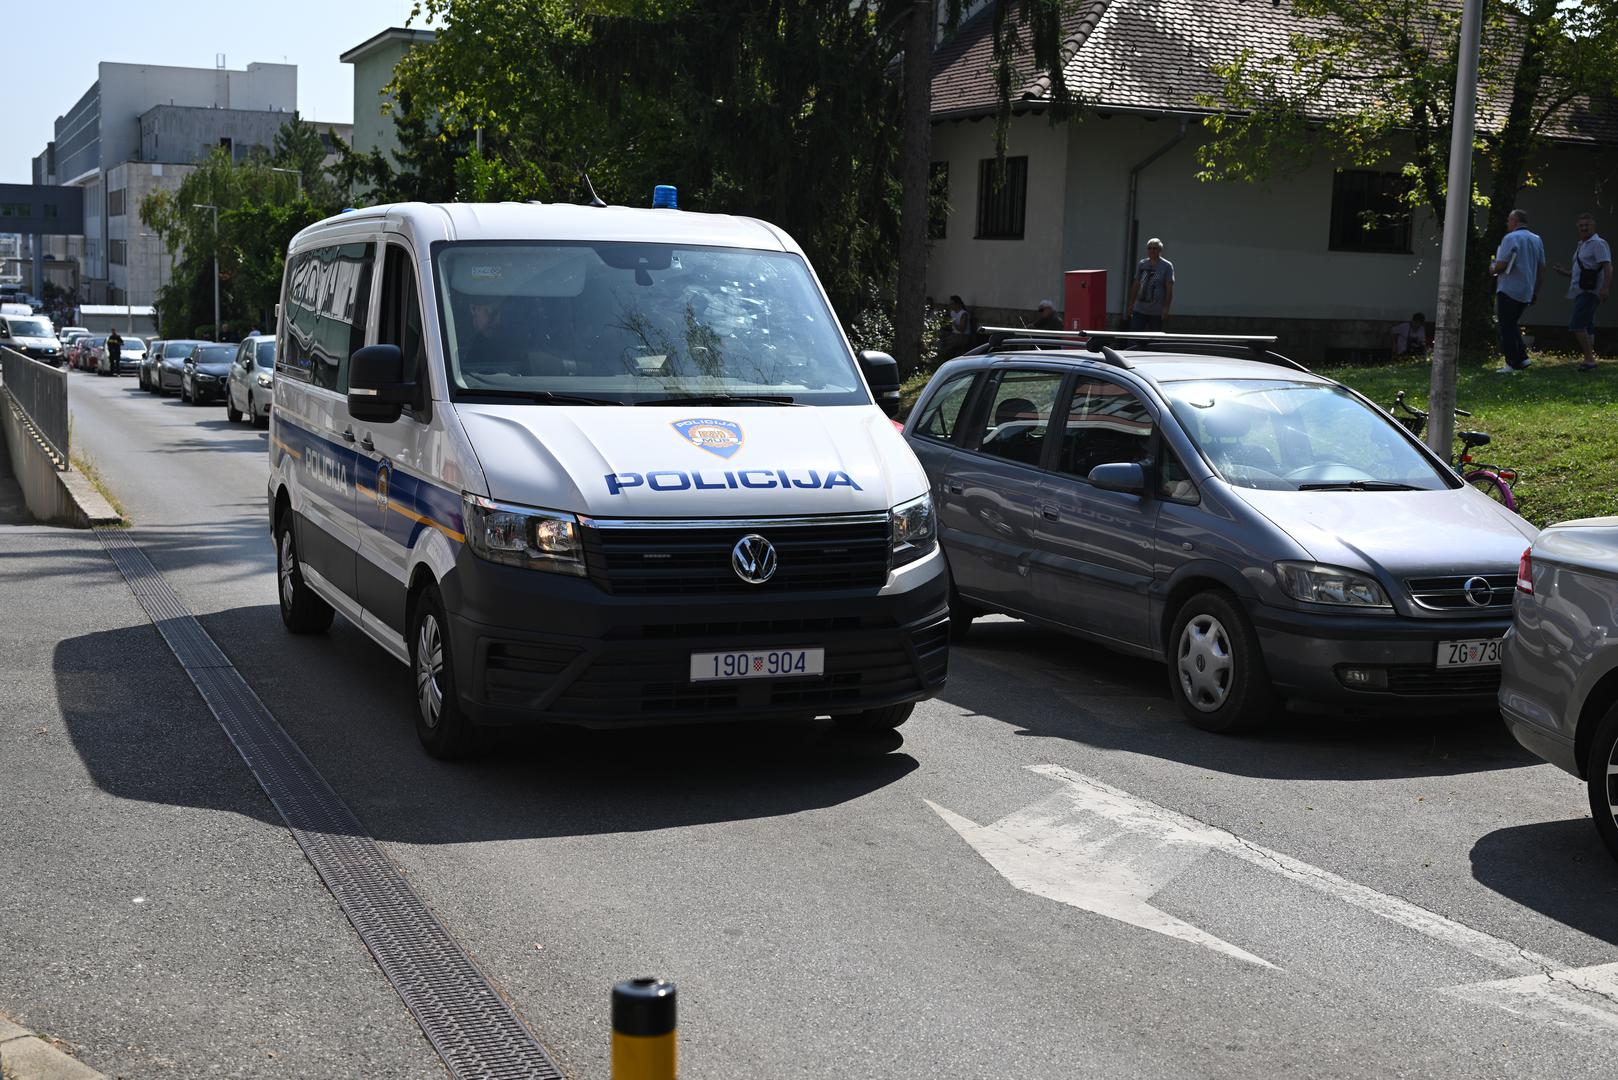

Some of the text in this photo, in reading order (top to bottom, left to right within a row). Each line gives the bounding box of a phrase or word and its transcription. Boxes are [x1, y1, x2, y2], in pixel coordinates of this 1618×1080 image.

[675, 419, 738, 428] POLICIJA
[305, 447, 348, 496] POLICIJA
[604, 469, 864, 495] POLICIJA
[713, 651, 806, 677] 190 904
[1448, 643, 1468, 664] ZG
